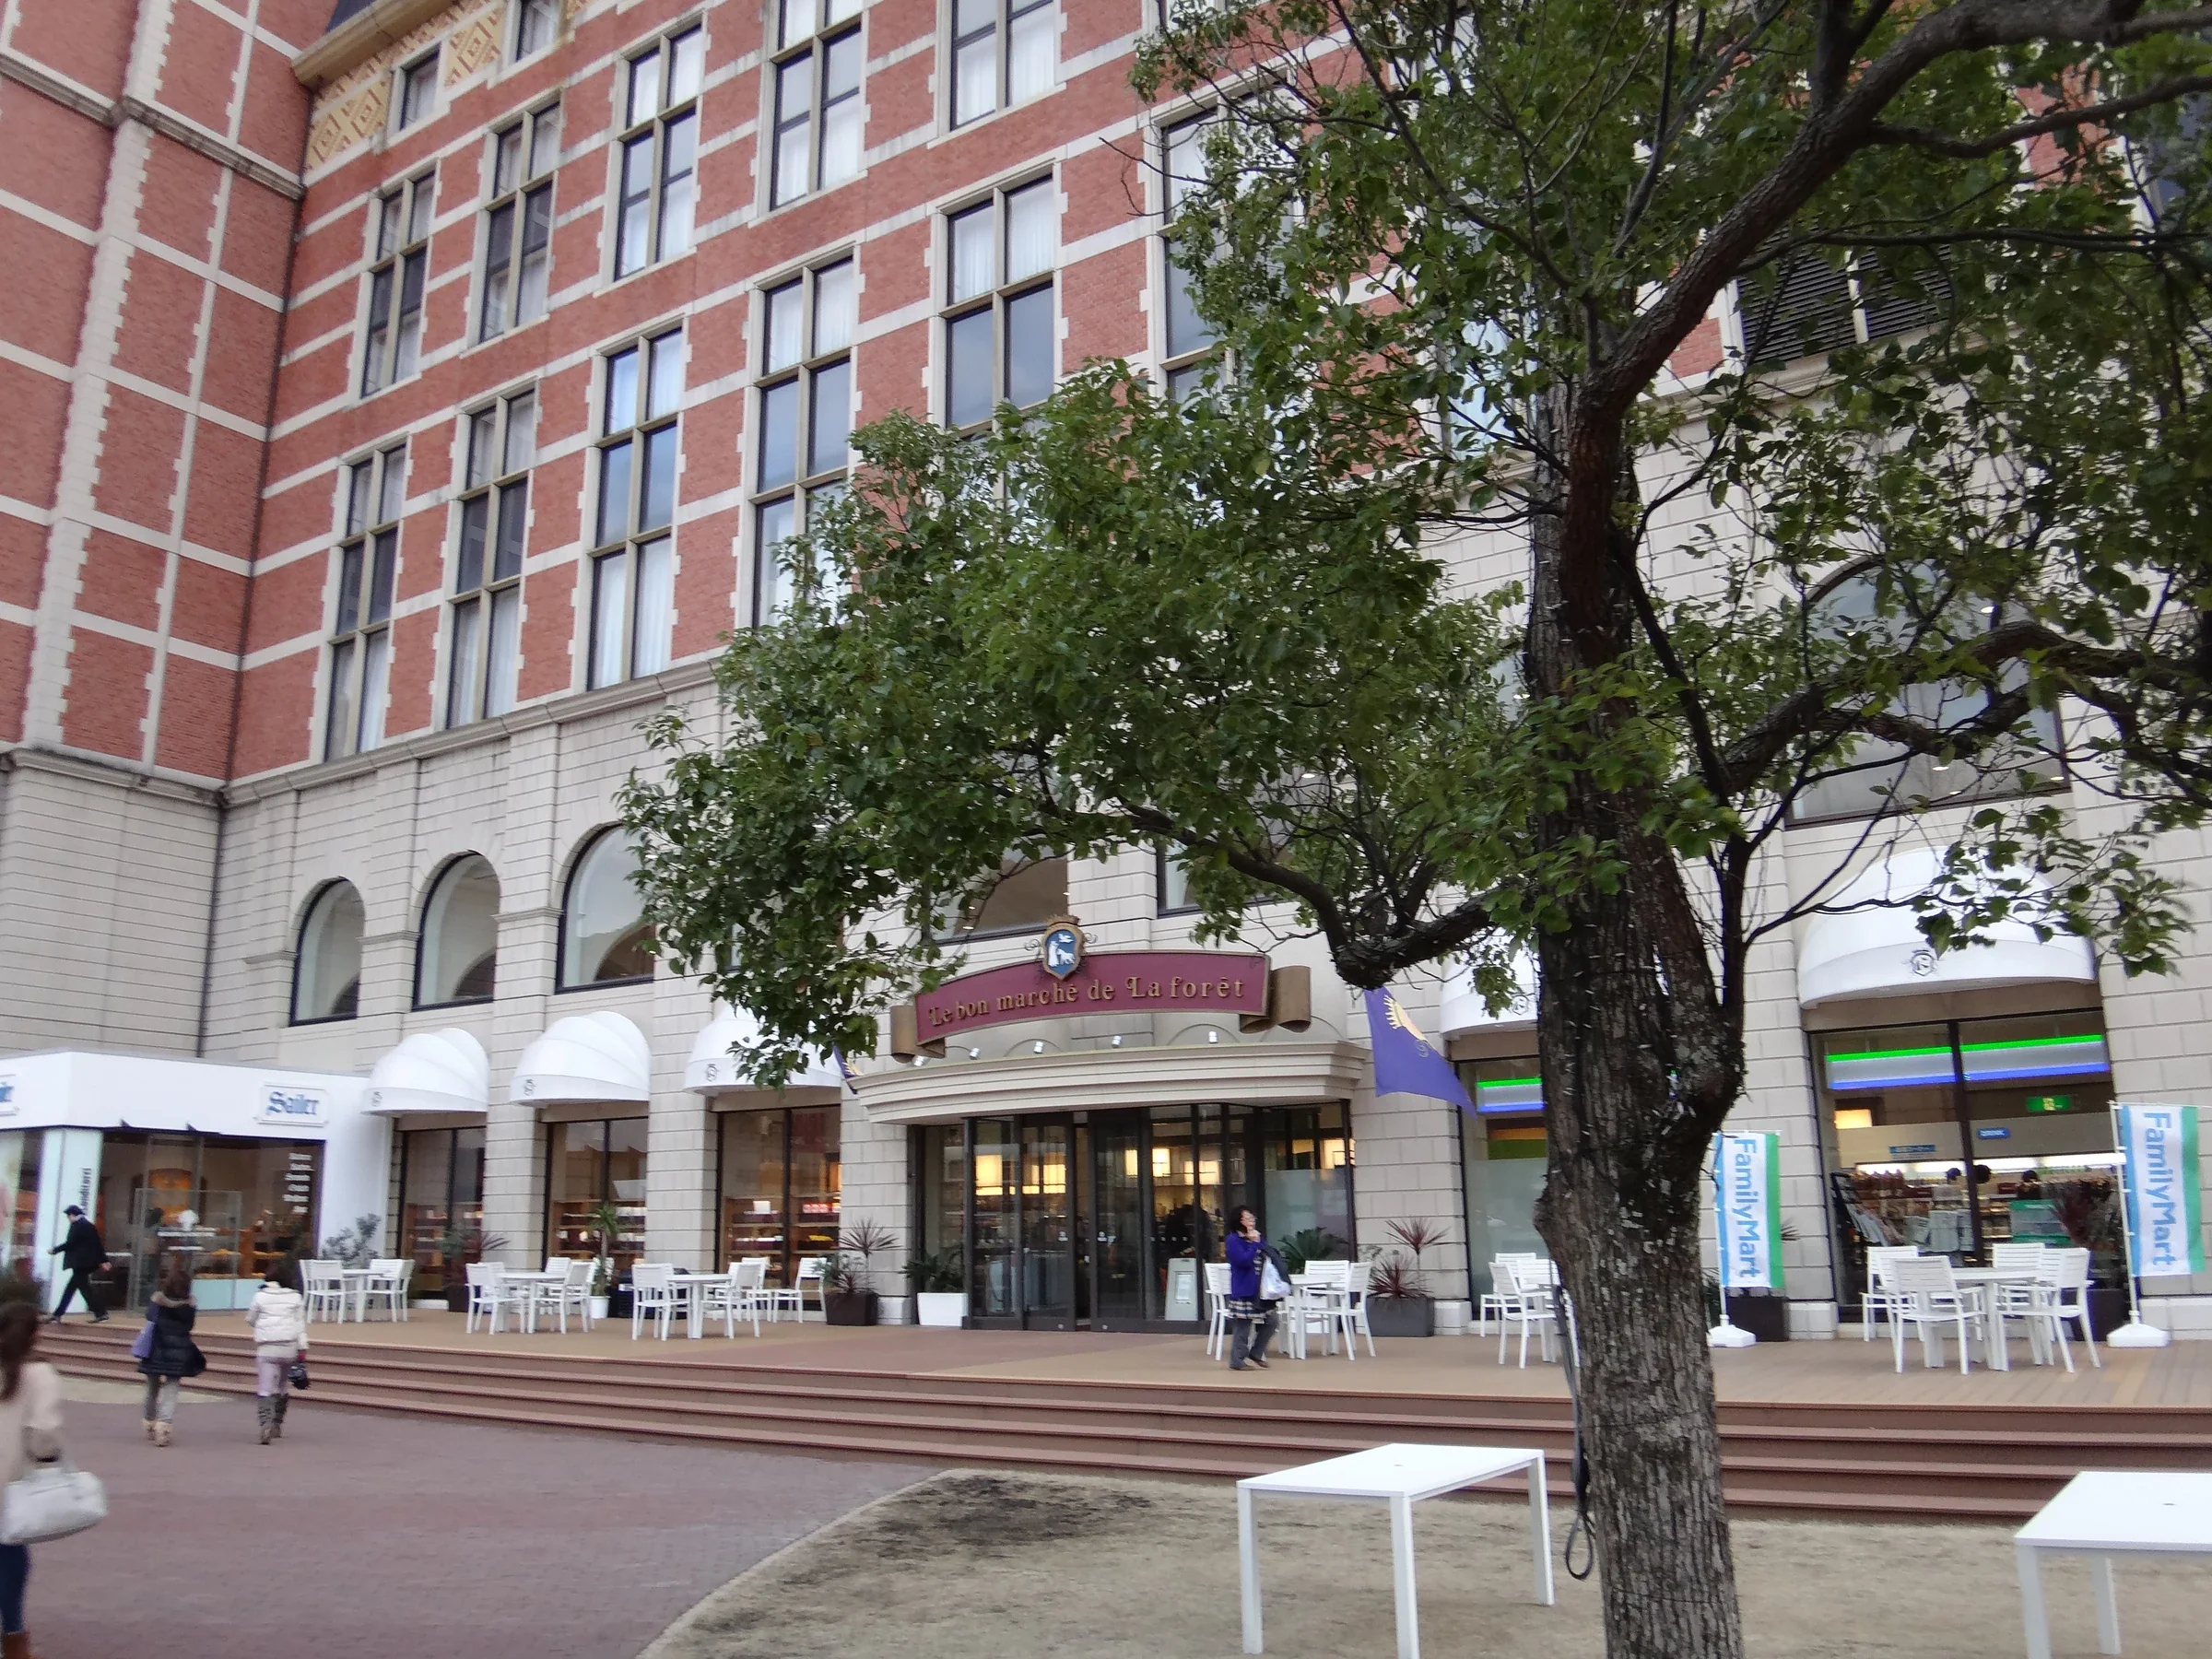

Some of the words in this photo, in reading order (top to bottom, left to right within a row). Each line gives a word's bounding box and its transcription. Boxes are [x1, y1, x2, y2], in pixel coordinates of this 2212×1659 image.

[928, 1006, 953, 1026] Le
[956, 1000, 989, 1020] bon
[1087, 979, 1115, 1000] de
[1125, 976, 1162, 998] La
[1170, 976, 1244, 998] forêt
[1732, 1138, 1761, 1278] FamilyMart
[2144, 1112, 2177, 1266] FamilyMart
